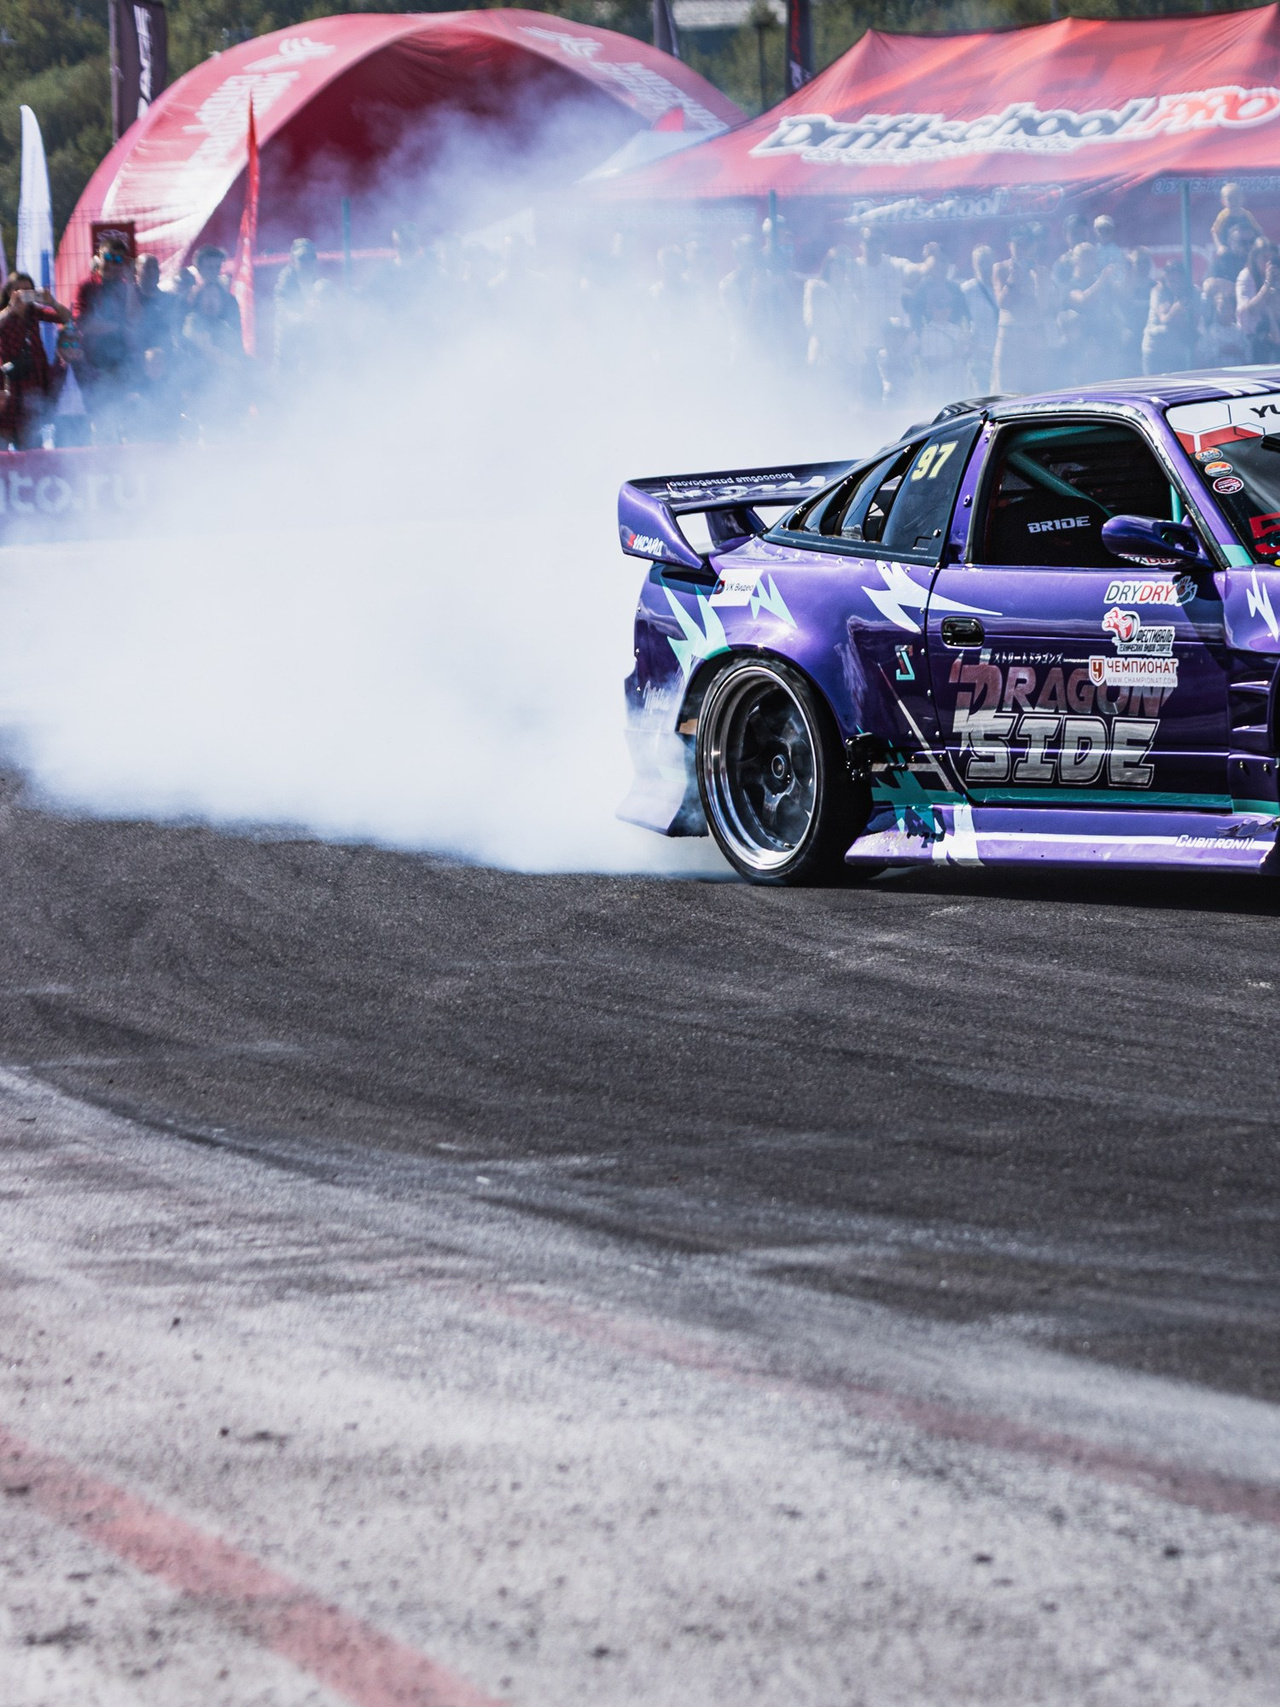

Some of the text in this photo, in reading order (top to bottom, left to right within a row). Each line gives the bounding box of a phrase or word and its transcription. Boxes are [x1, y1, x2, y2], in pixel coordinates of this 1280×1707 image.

[911, 440, 959, 482] 97
[1027, 515, 1092, 534] BRIDE
[1106, 584, 1177, 602] DRYDRY
[1107, 660, 1177, 674] ЧЕМПИОНАТ
[949, 650, 1175, 724] DRAGON
[965, 712, 1161, 789] SIDE
